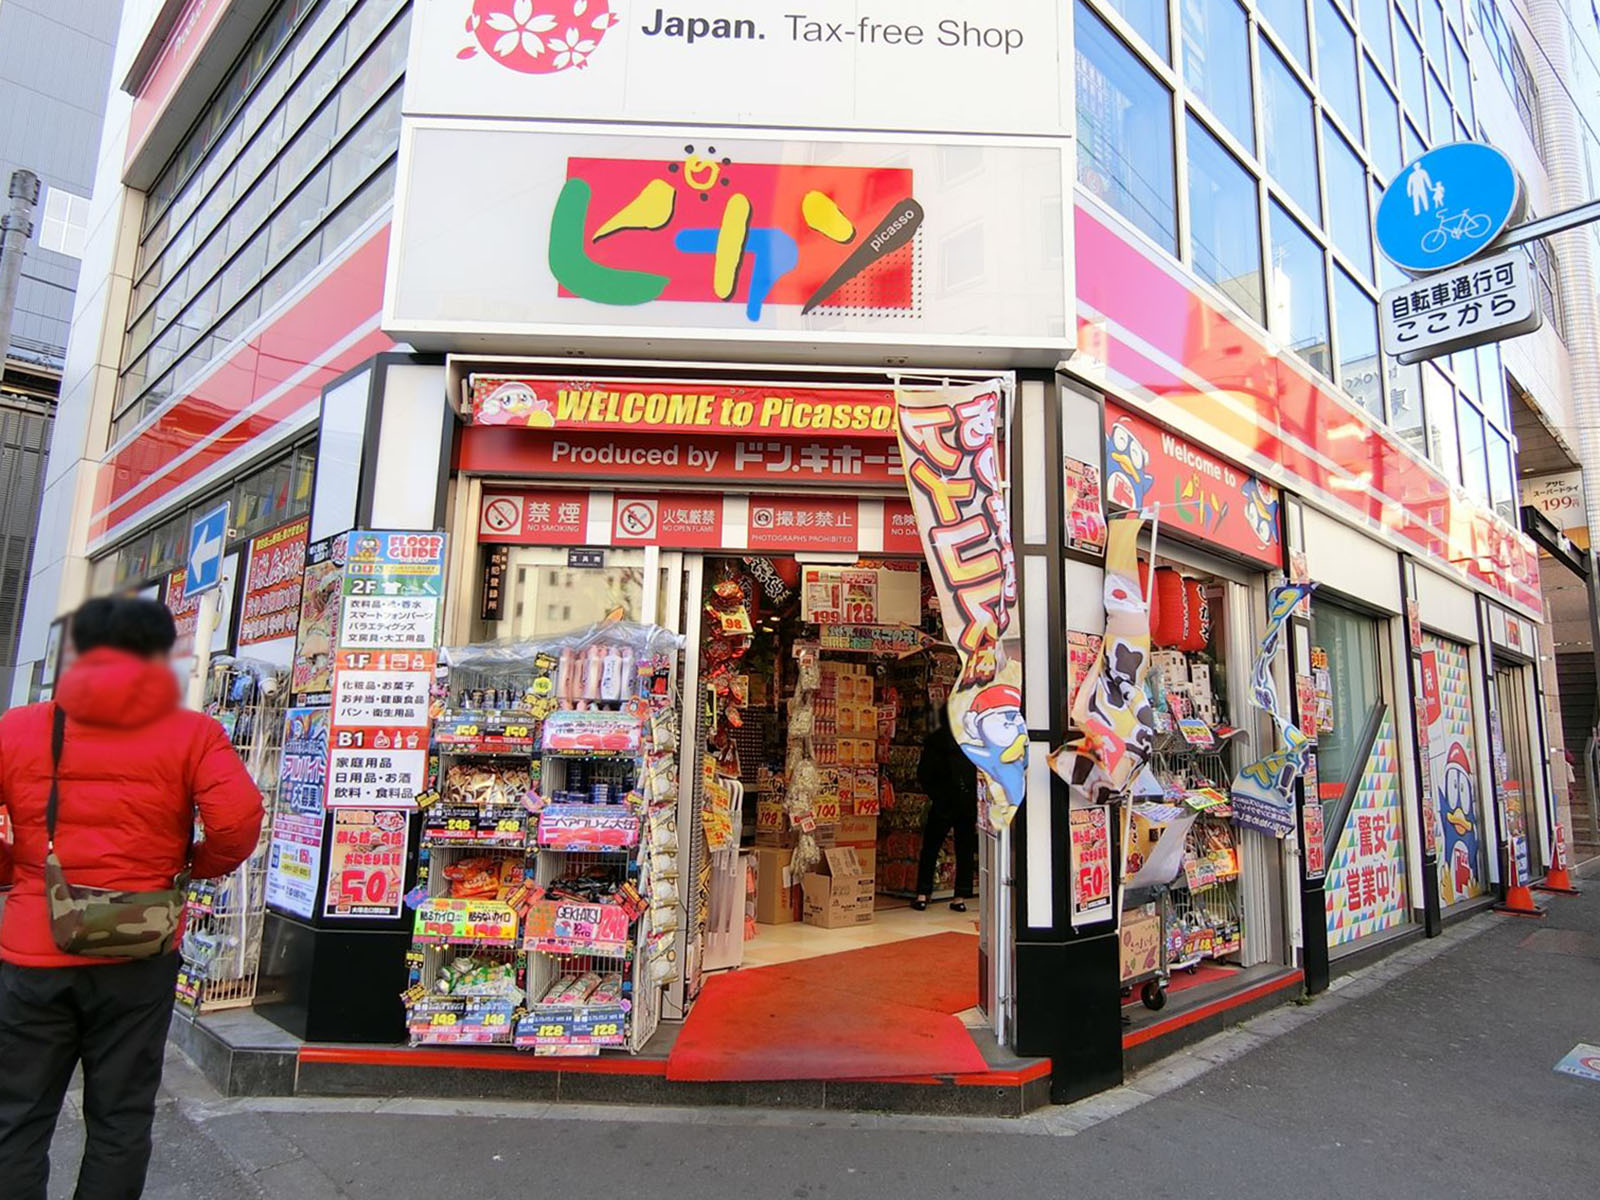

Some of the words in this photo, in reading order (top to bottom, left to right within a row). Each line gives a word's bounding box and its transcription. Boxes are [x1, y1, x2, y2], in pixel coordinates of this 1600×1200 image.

[641, 8, 766, 42] Japan.
[784, 14, 925, 46] Tax-free
[937, 20, 1024, 54] Shop
[867, 207, 916, 253] picasso
[1392, 262, 1514, 319] 自転車通行可
[1397, 294, 1516, 342] ここから
[556, 390, 714, 426] WELCOME
[720, 396, 754, 428] to
[552, 441, 679, 466] Produced
[687, 445, 719, 472] by
[1161, 432, 1222, 480] Welcome
[1223, 467, 1237, 488] to
[1534, 485, 1579, 497] スーパードライ
[1545, 480, 1566, 488] アサヒ
[527, 502, 581, 523] 禁煙
[662, 509, 715, 525] 火気厳禁
[775, 510, 853, 528] 撮影禁止
[527, 524, 539, 533] NO
[541, 525, 580, 533] SMOKING
[891, 528, 904, 536] NO
[389, 535, 443, 547] FLOOR
[752, 534, 806, 544] PHOTOGRAPHS
[808, 535, 854, 544] PROHIBITED
[388, 547, 439, 558] GUIDE
[351, 579, 378, 594] 2F
[811, 610, 840, 623] 199
[846, 603, 874, 623] 128
[345, 653, 372, 669] 1F
[338, 731, 365, 747] B1
[336, 757, 392, 769] 家庭用品
[1358, 813, 1388, 856] 驚安
[1346, 863, 1397, 912] 営業中!
